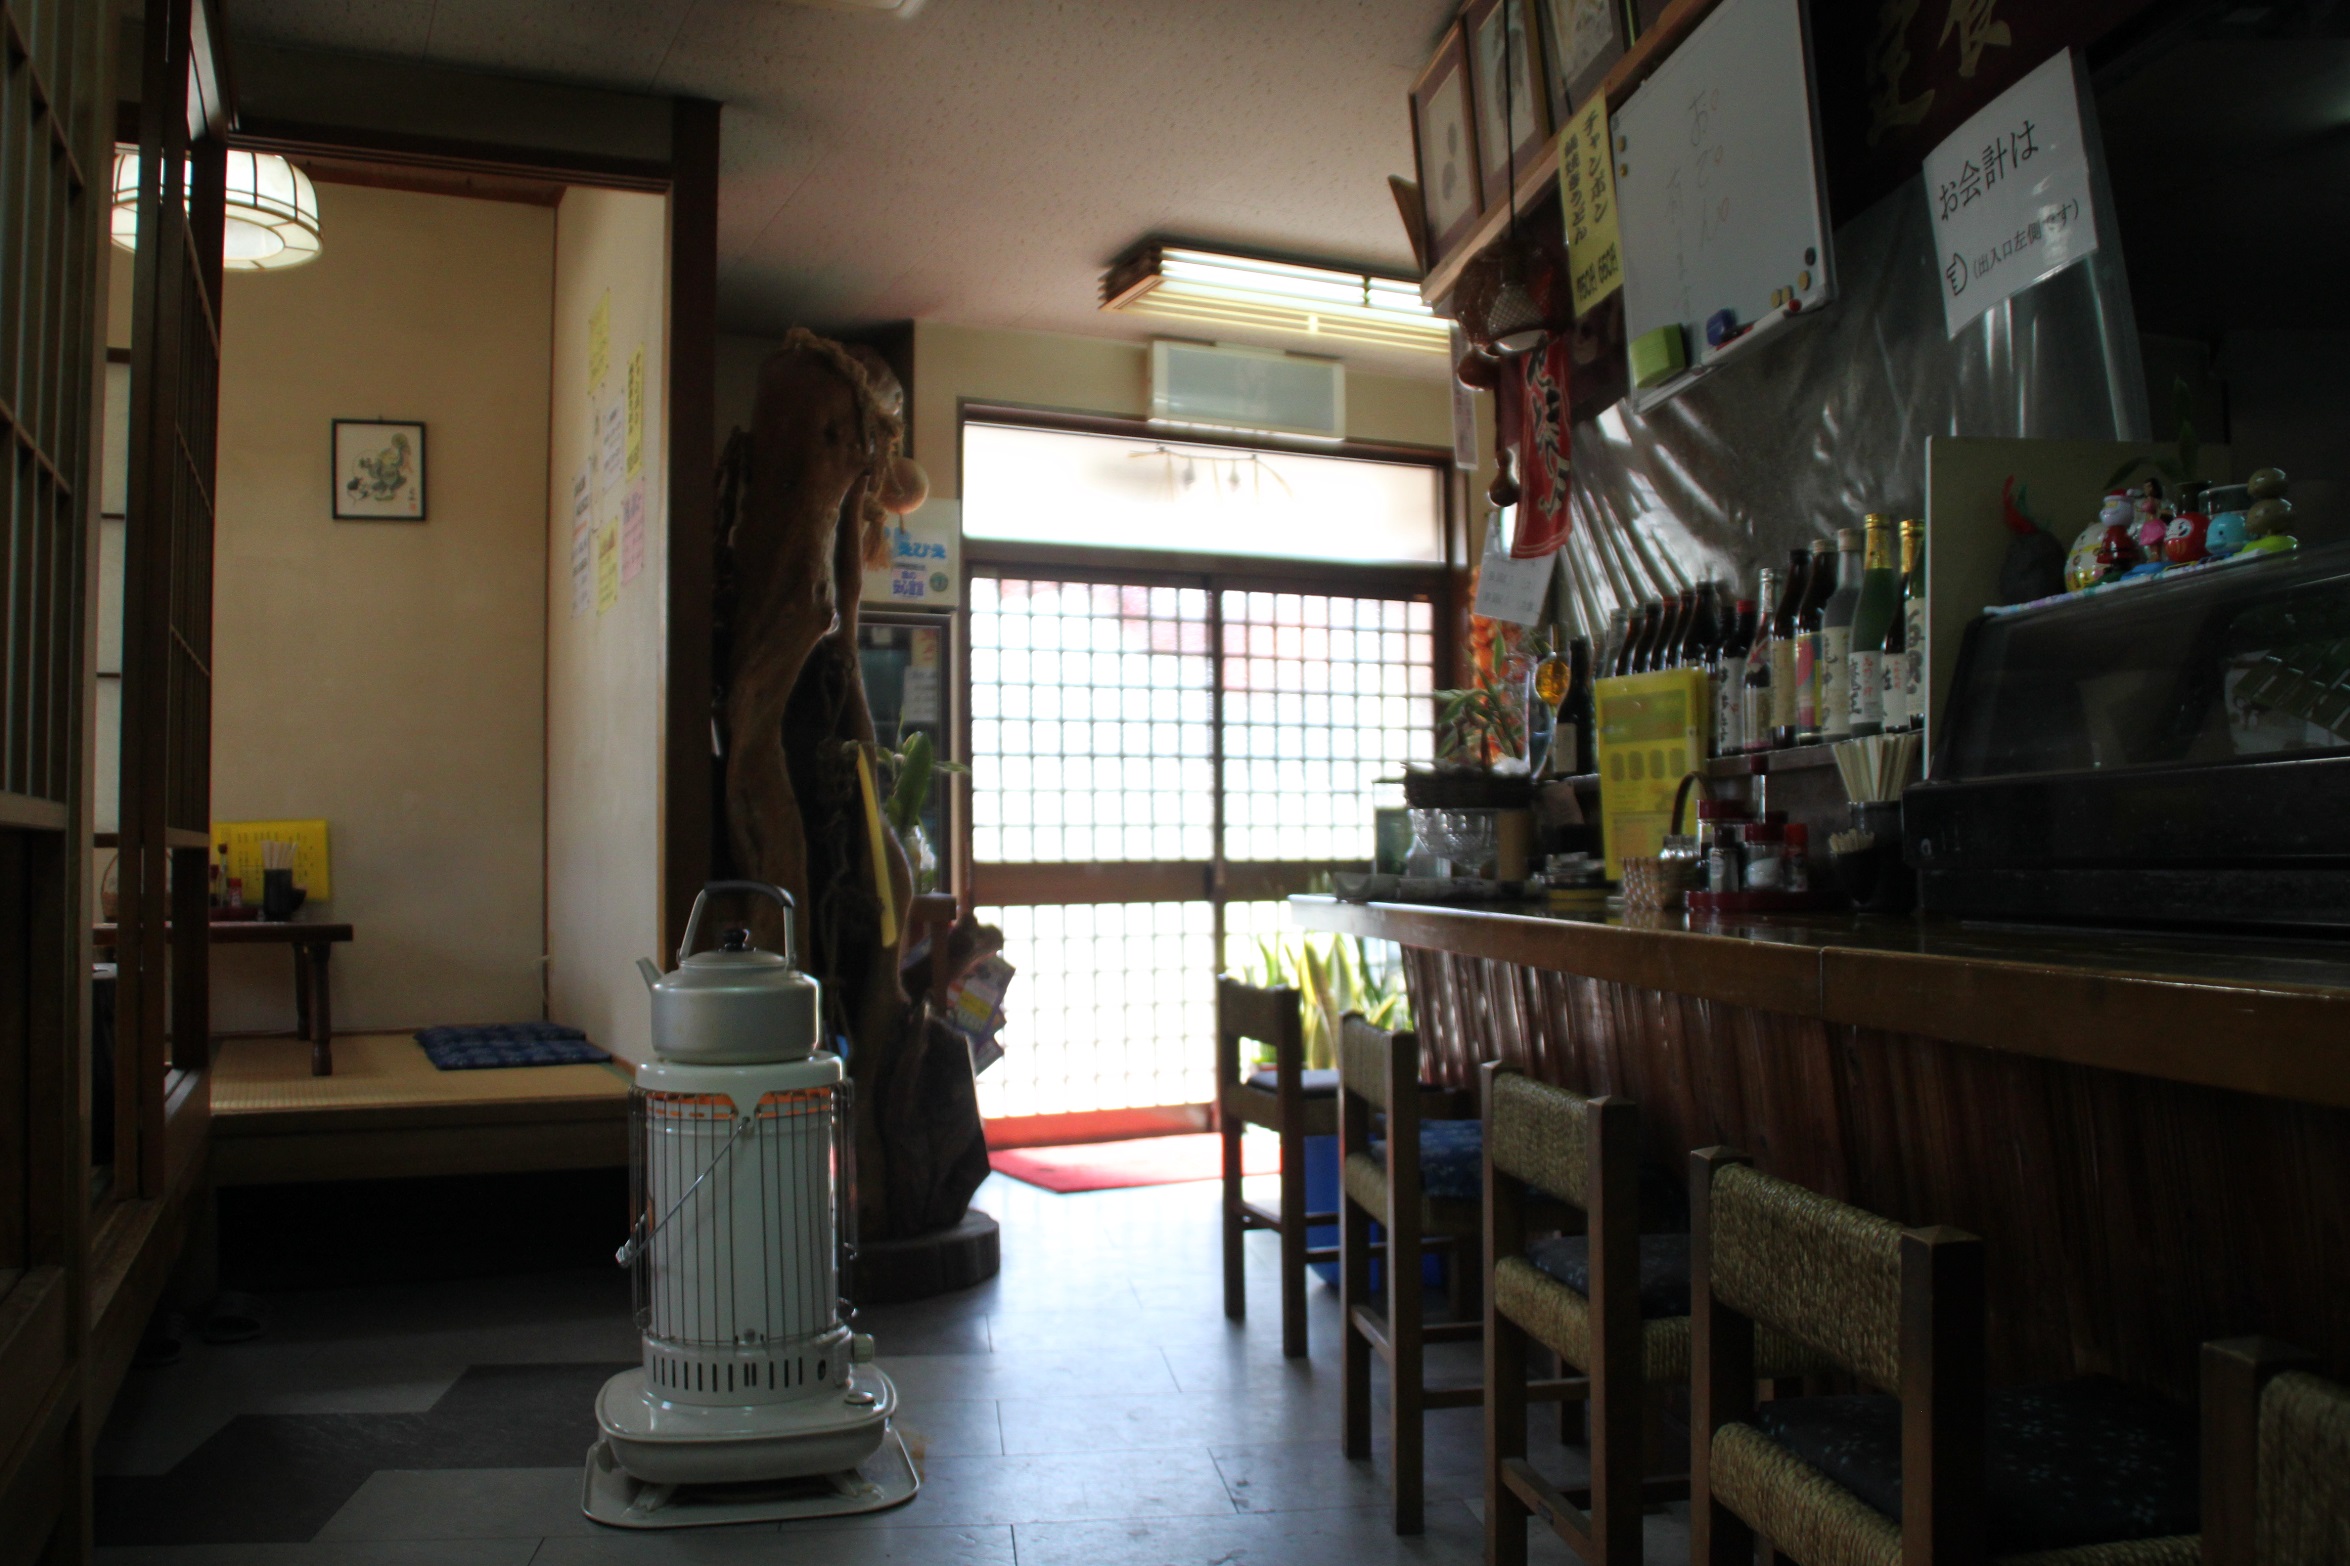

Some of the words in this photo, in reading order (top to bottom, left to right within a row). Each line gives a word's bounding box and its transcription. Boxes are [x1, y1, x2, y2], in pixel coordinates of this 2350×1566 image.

[1584, 108, 1609, 225] チャンポン
[1940, 119, 2039, 222] お会計は
